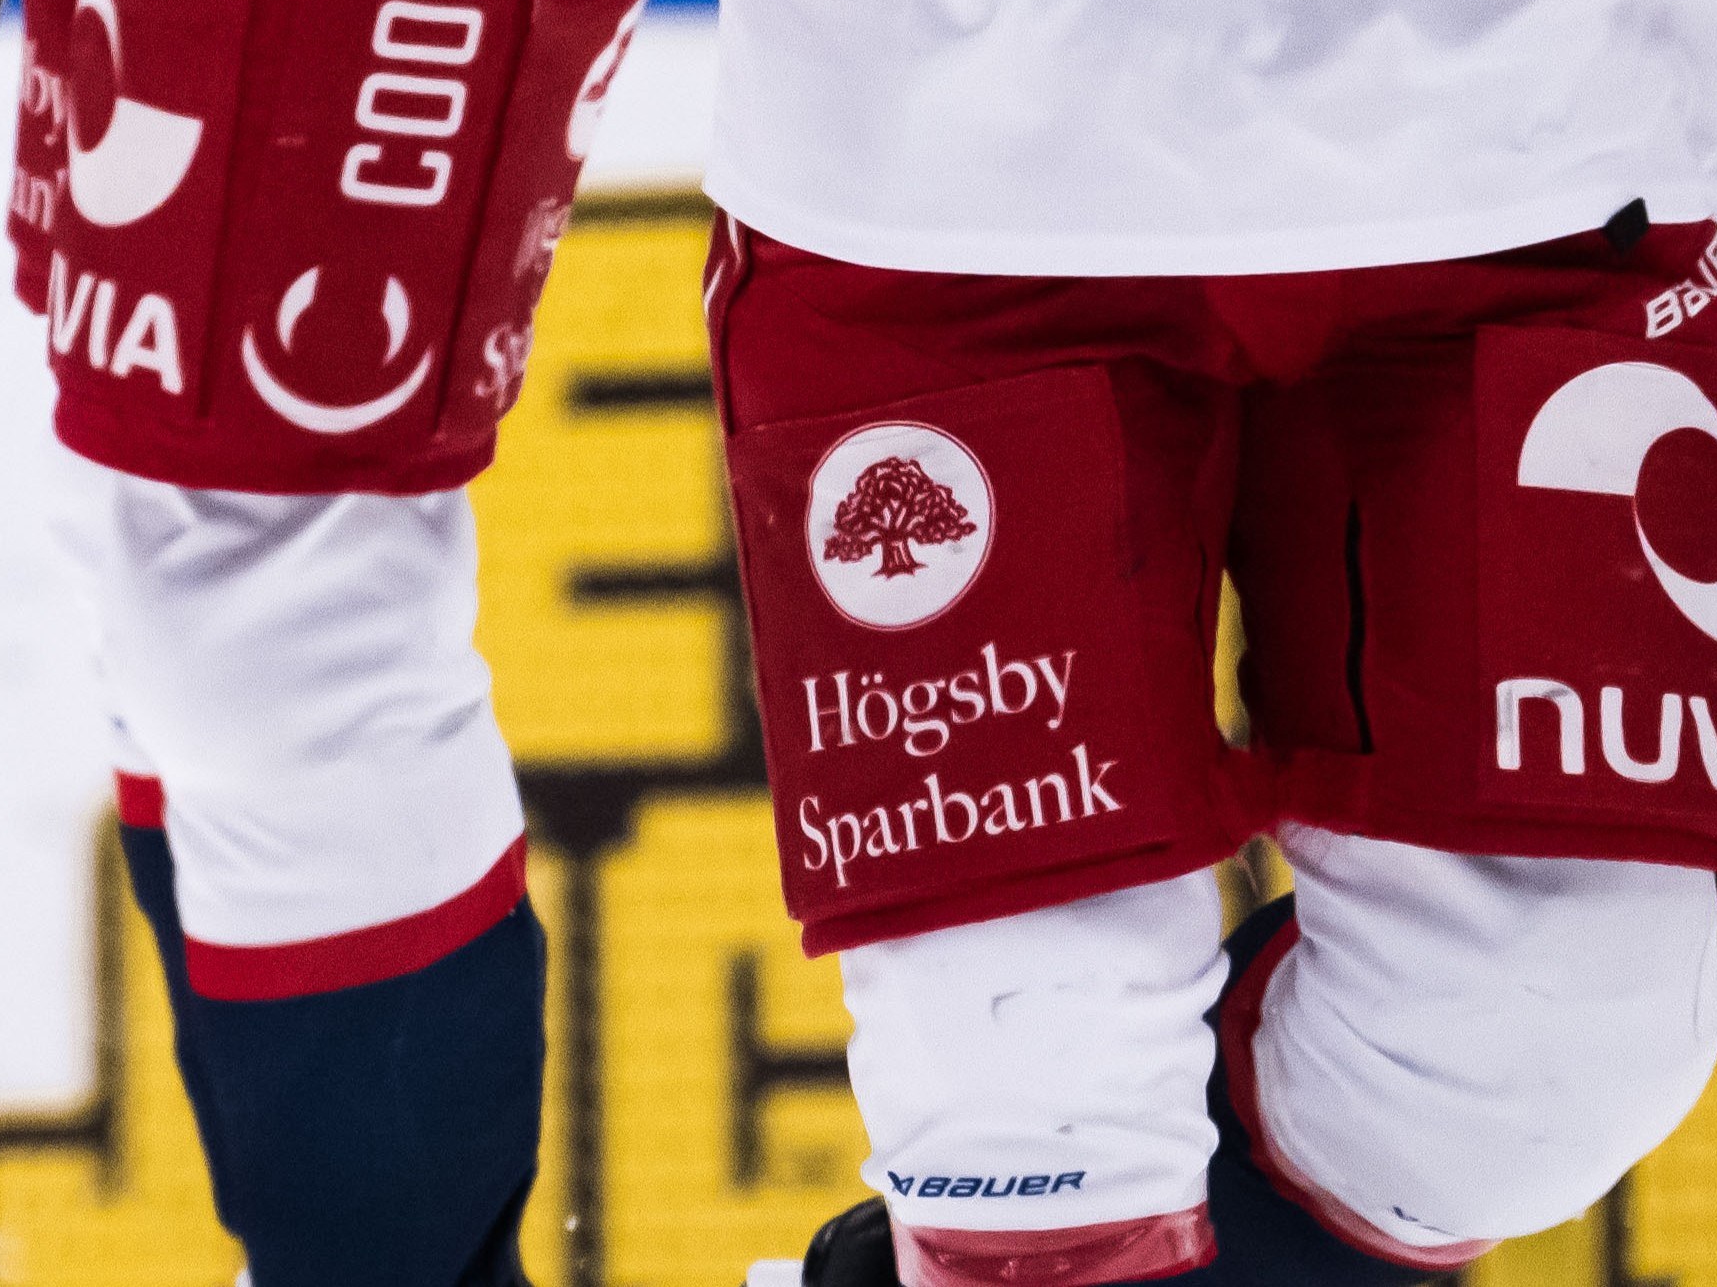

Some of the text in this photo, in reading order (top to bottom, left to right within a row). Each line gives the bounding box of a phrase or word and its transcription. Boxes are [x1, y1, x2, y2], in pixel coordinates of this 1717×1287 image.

[48, 250, 185, 396] VIA
[804, 641, 1078, 757] Högsby
[800, 743, 1125, 887] Sparbank
[917, 1169, 1087, 1200] BAUER
